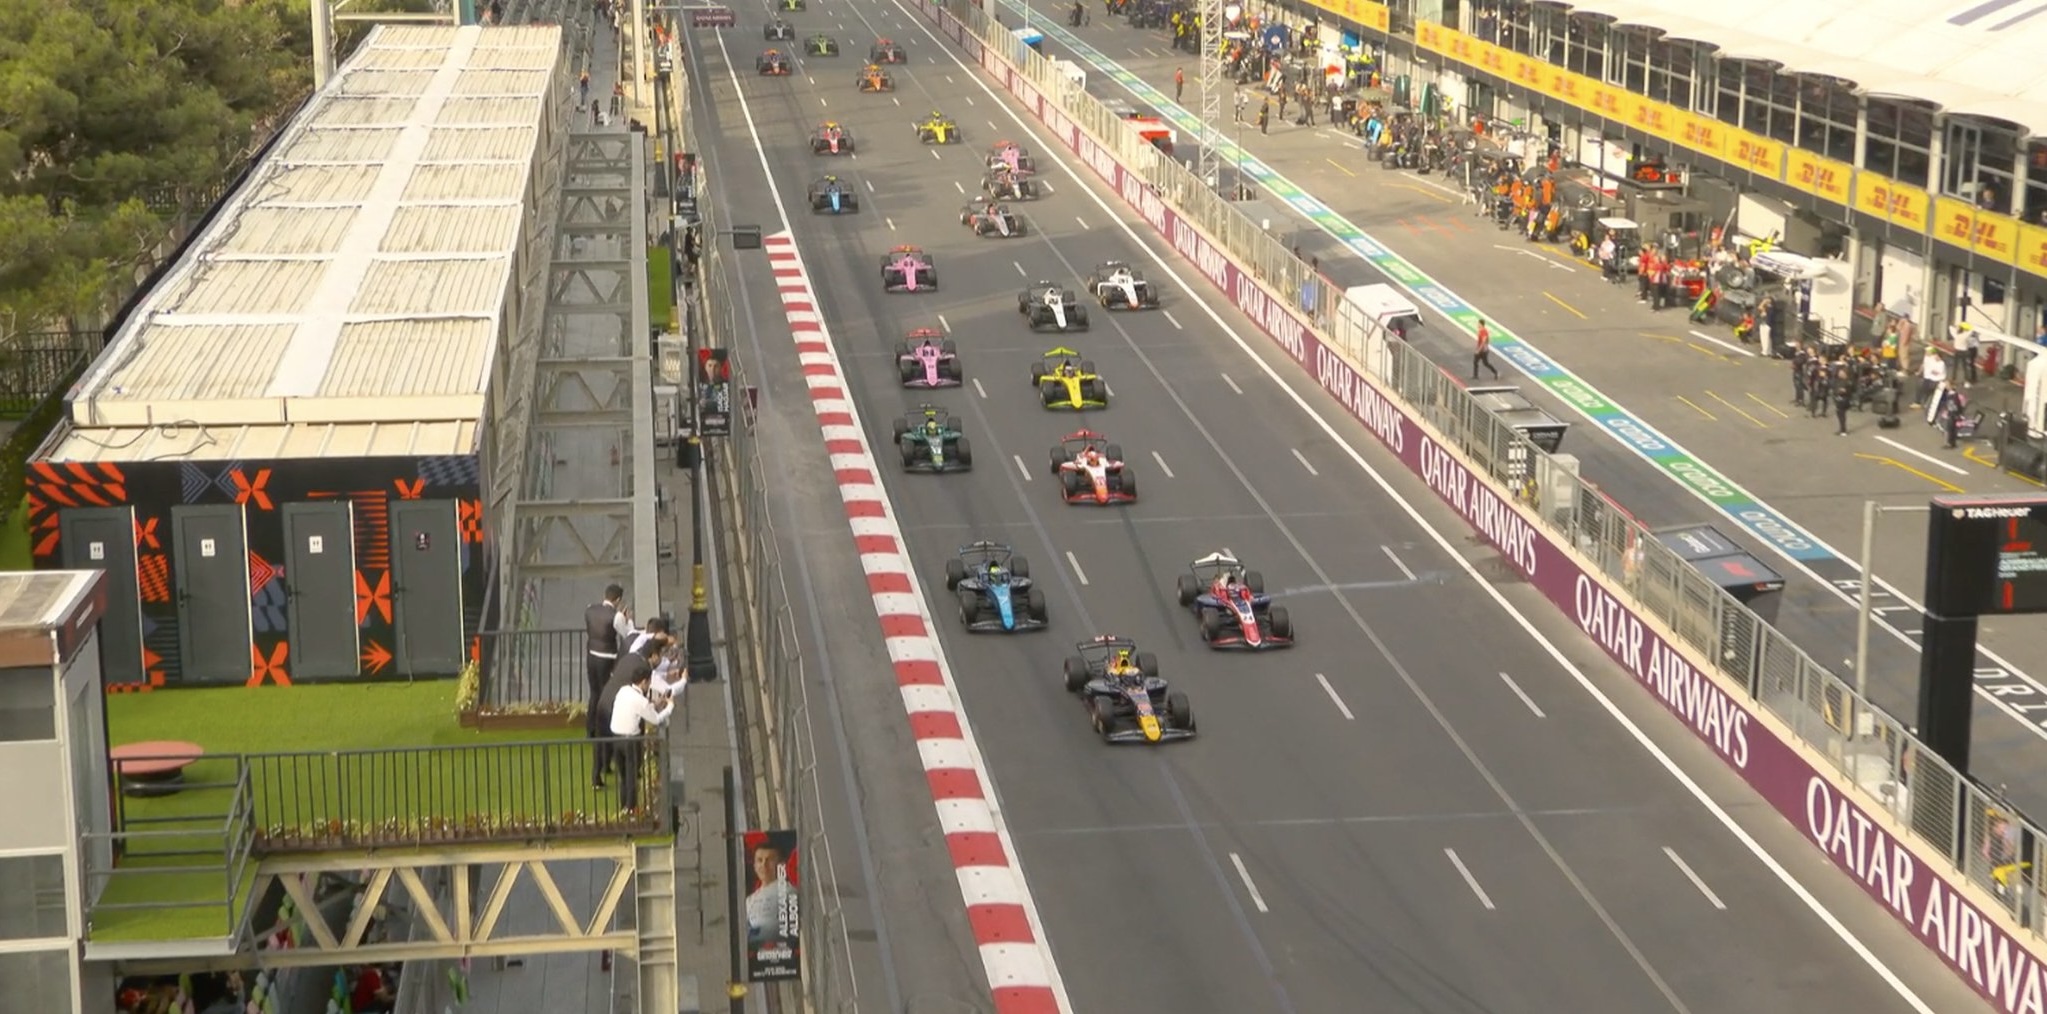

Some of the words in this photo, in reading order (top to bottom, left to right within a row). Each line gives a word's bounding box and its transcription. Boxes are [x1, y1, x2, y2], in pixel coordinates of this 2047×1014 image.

[1173, 216, 1197, 264] QATAR
[1953, 213, 1997, 250] DHL
[1237, 271, 1265, 327] QATAR
[1264, 299, 1305, 361] AIRWAYS
[1316, 343, 1352, 408] QATAR
[1353, 377, 1403, 453] AIRWAYS
[1419, 435, 1467, 516] QATAR
[1468, 482, 1537, 577] AIRWAYS
[1574, 573, 1643, 678] QATAR
[1647, 648, 1749, 769] AIRWAYS
[777, 863, 788, 938] ALEXANDER
[788, 893, 799, 938] ALBON
[1806, 775, 1915, 926] QATAR
[1918, 876, 2047, 1014] AIRWA
